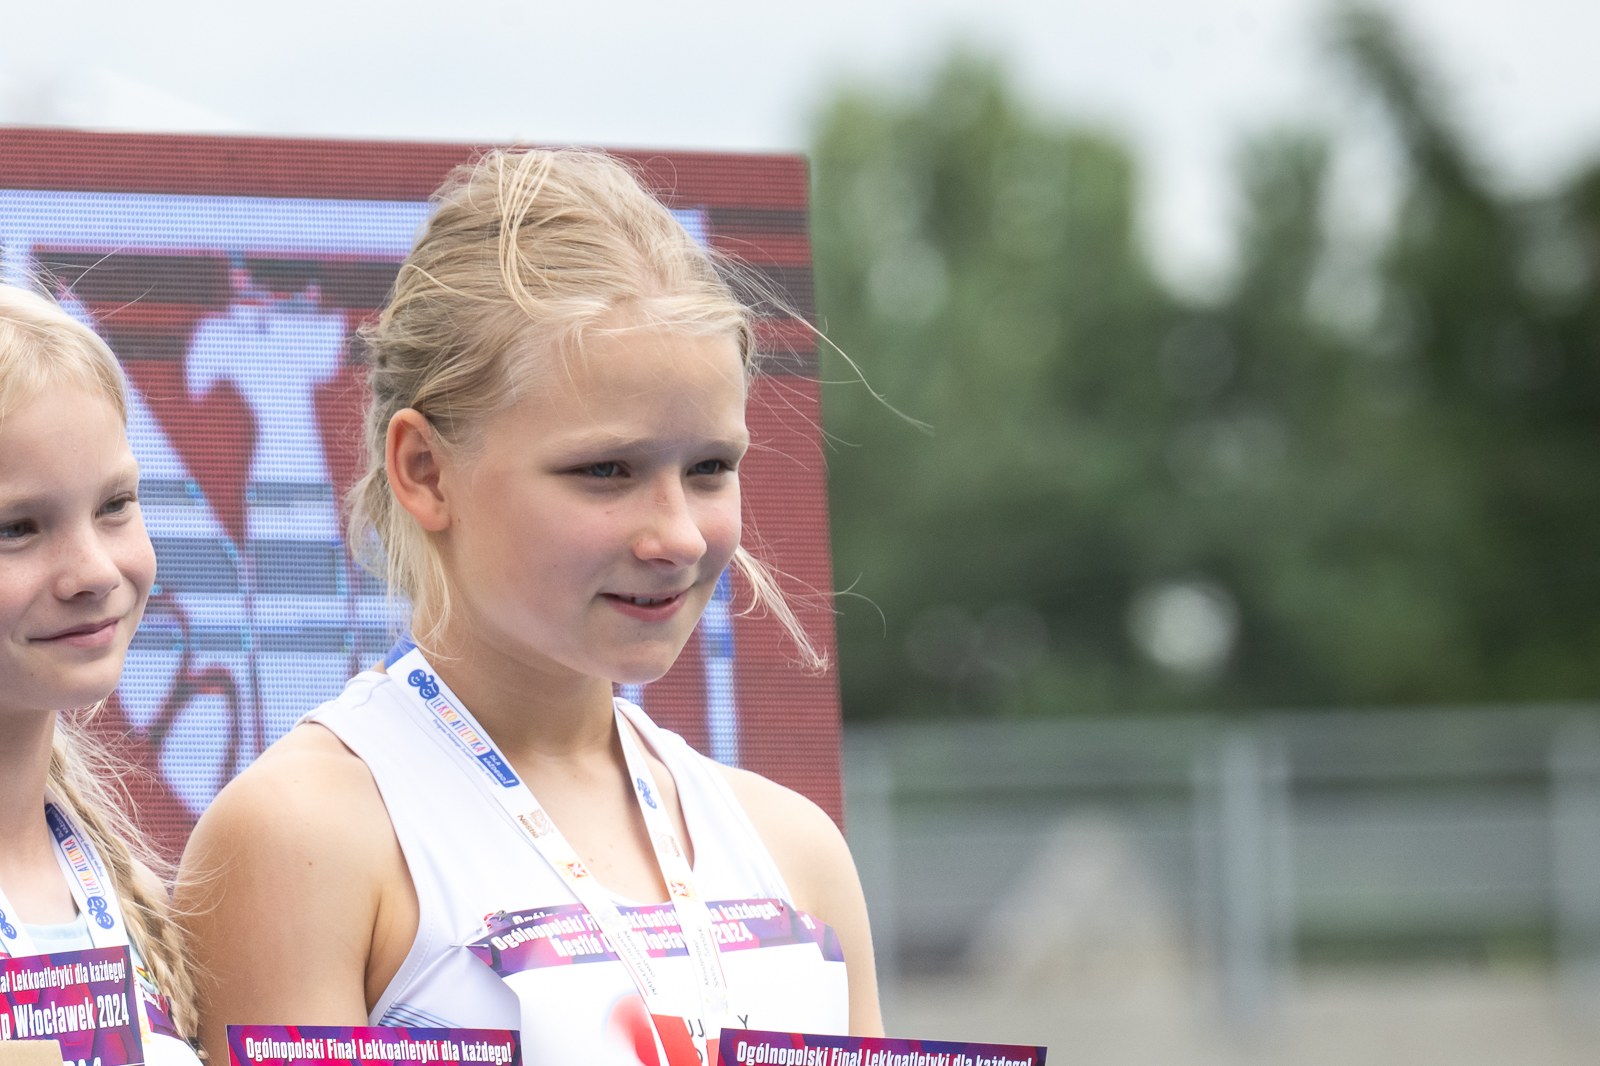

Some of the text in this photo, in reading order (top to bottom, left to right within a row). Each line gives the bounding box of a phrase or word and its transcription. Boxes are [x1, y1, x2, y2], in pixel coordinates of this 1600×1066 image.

[431, 698, 486, 752] LEKKOATLETYKA
[489, 755, 501, 766] DLA
[64, 839, 100, 894] LEKKOATLETYKA
[490, 913, 585, 951] Ogólnopolski
[550, 932, 603, 957] Nestlé
[715, 921, 753, 944] 2024
[12, 965, 74, 993] Lekkoatletyki
[74, 963, 90, 983] dla
[90, 958, 126, 983] każdego!
[13, 996, 96, 1040] Włocławek
[97, 993, 130, 1028] 2024
[246, 1036, 512, 1066] Ogólnopolski Finał Lekkoatletyki dla każdego!
